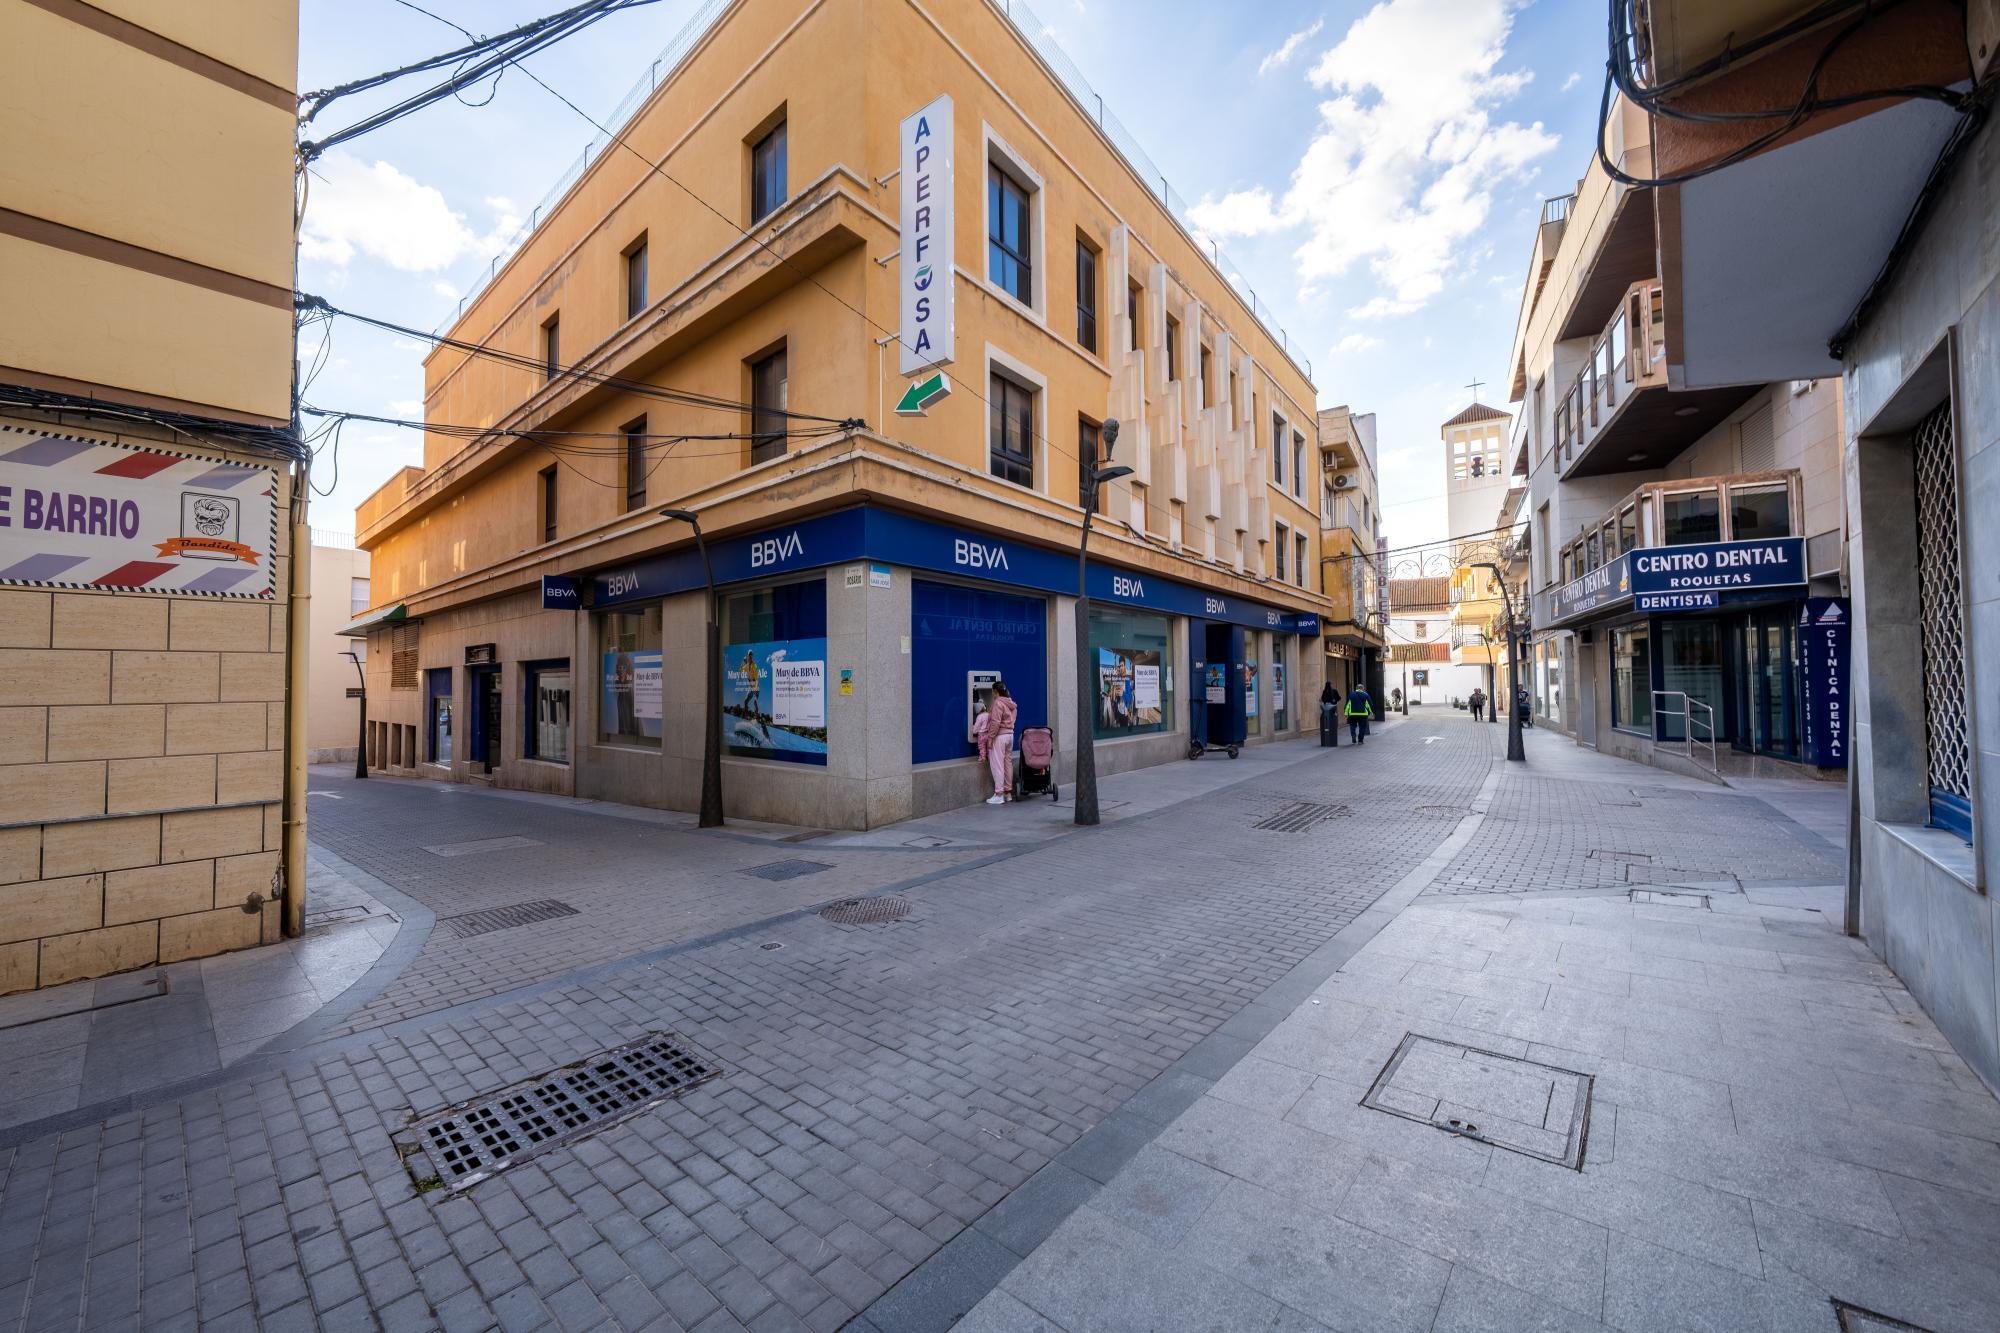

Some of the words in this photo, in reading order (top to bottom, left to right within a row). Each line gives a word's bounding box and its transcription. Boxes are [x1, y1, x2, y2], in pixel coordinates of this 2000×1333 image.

[23, 488, 140, 540] BARRIO
[751, 530, 804, 568] BBVA
[954, 538, 1009, 570] BBVA
[1636, 550, 1709, 573] CENTRO
[1715, 546, 1788, 568] DENTAL
[608, 571, 639, 597] BBVA
[1113, 576, 1144, 598] BBVA
[1376, 538, 1389, 624] MUEBLES
[1562, 582, 1584, 604] CENTRO
[1584, 567, 1611, 593] DENTAL
[1670, 573, 1752, 587] ROQUETAS
[546, 588, 577, 597] BBVA
[1573, 596, 1597, 612] ROQUETAS
[1641, 594, 1713, 608] DENTISTA
[1206, 597, 1226, 615] BBVA
[1267, 611, 1281, 625] BBVA
[776, 668, 790, 679] Muy
[791, 667, 800, 677] de
[800, 667, 820, 677] BBVA
[1829, 702, 1841, 757] DENTAL
